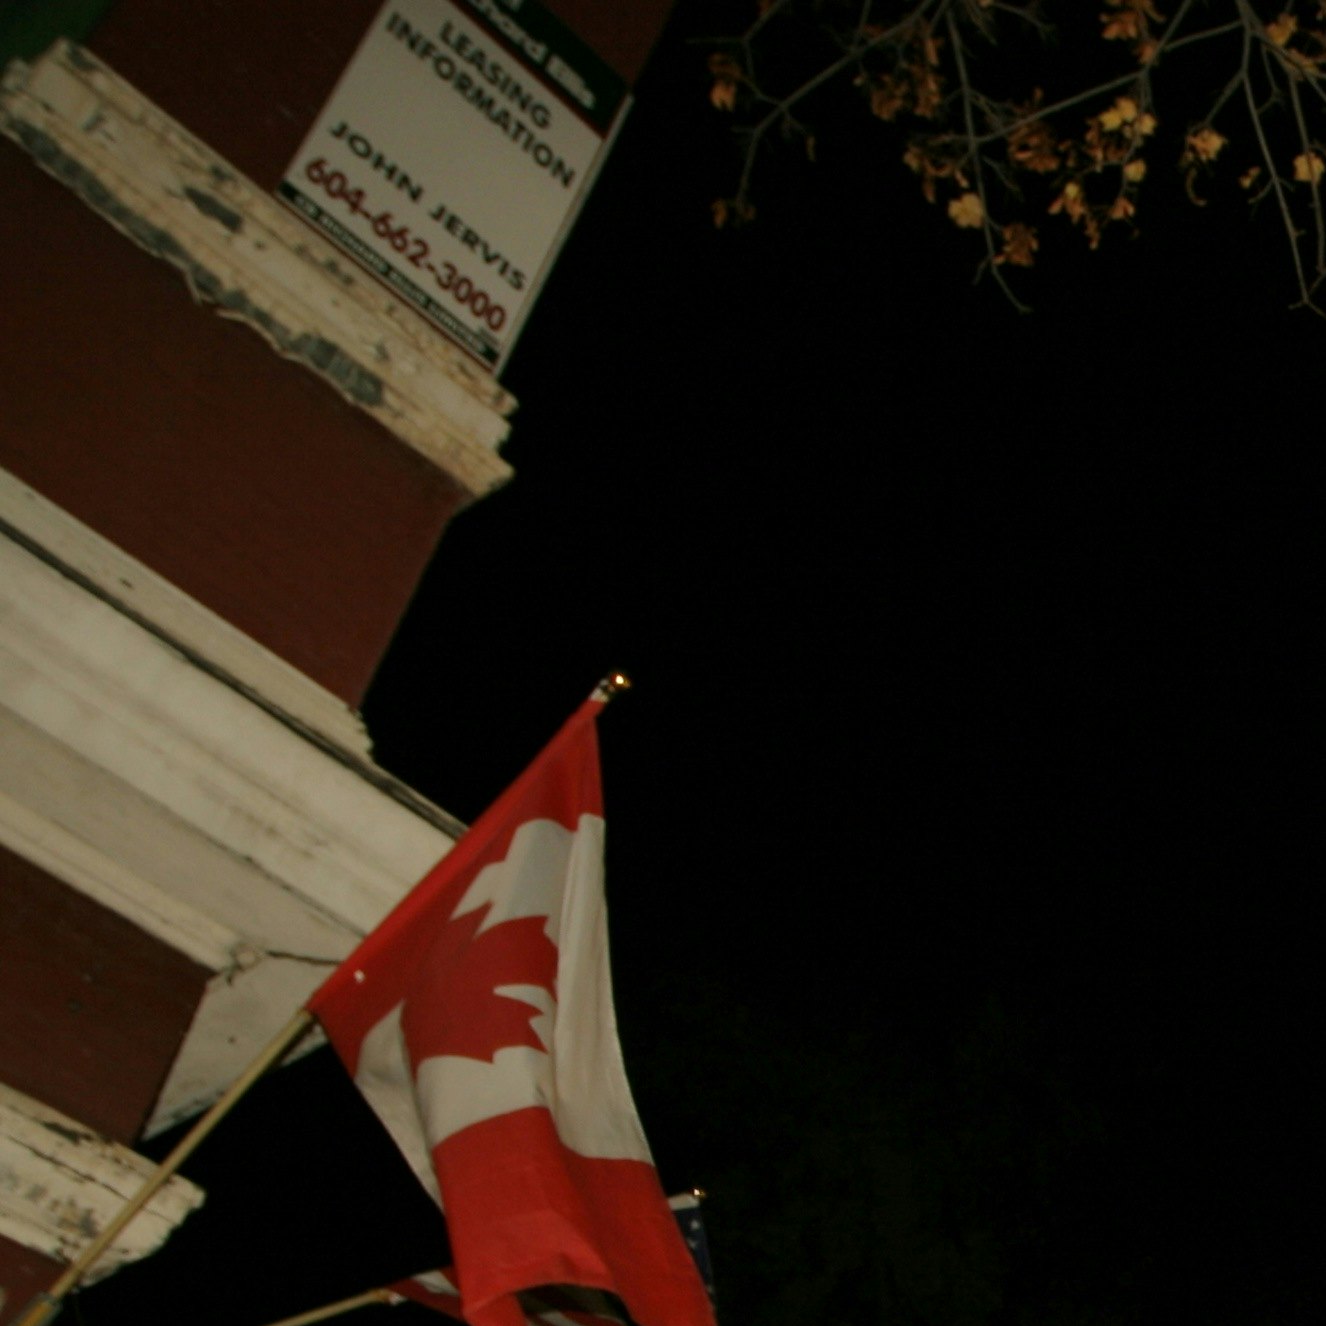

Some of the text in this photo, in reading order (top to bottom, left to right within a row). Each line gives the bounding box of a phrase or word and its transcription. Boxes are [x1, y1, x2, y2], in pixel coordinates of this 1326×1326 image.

[386, 12, 575, 188] INFORMATION
[440, 21, 550, 128] LEASING
[306, 157, 506, 332] 604-662-3000
[330, 122, 423, 202] JOHN
[430, 204, 526, 291] JERVIS
